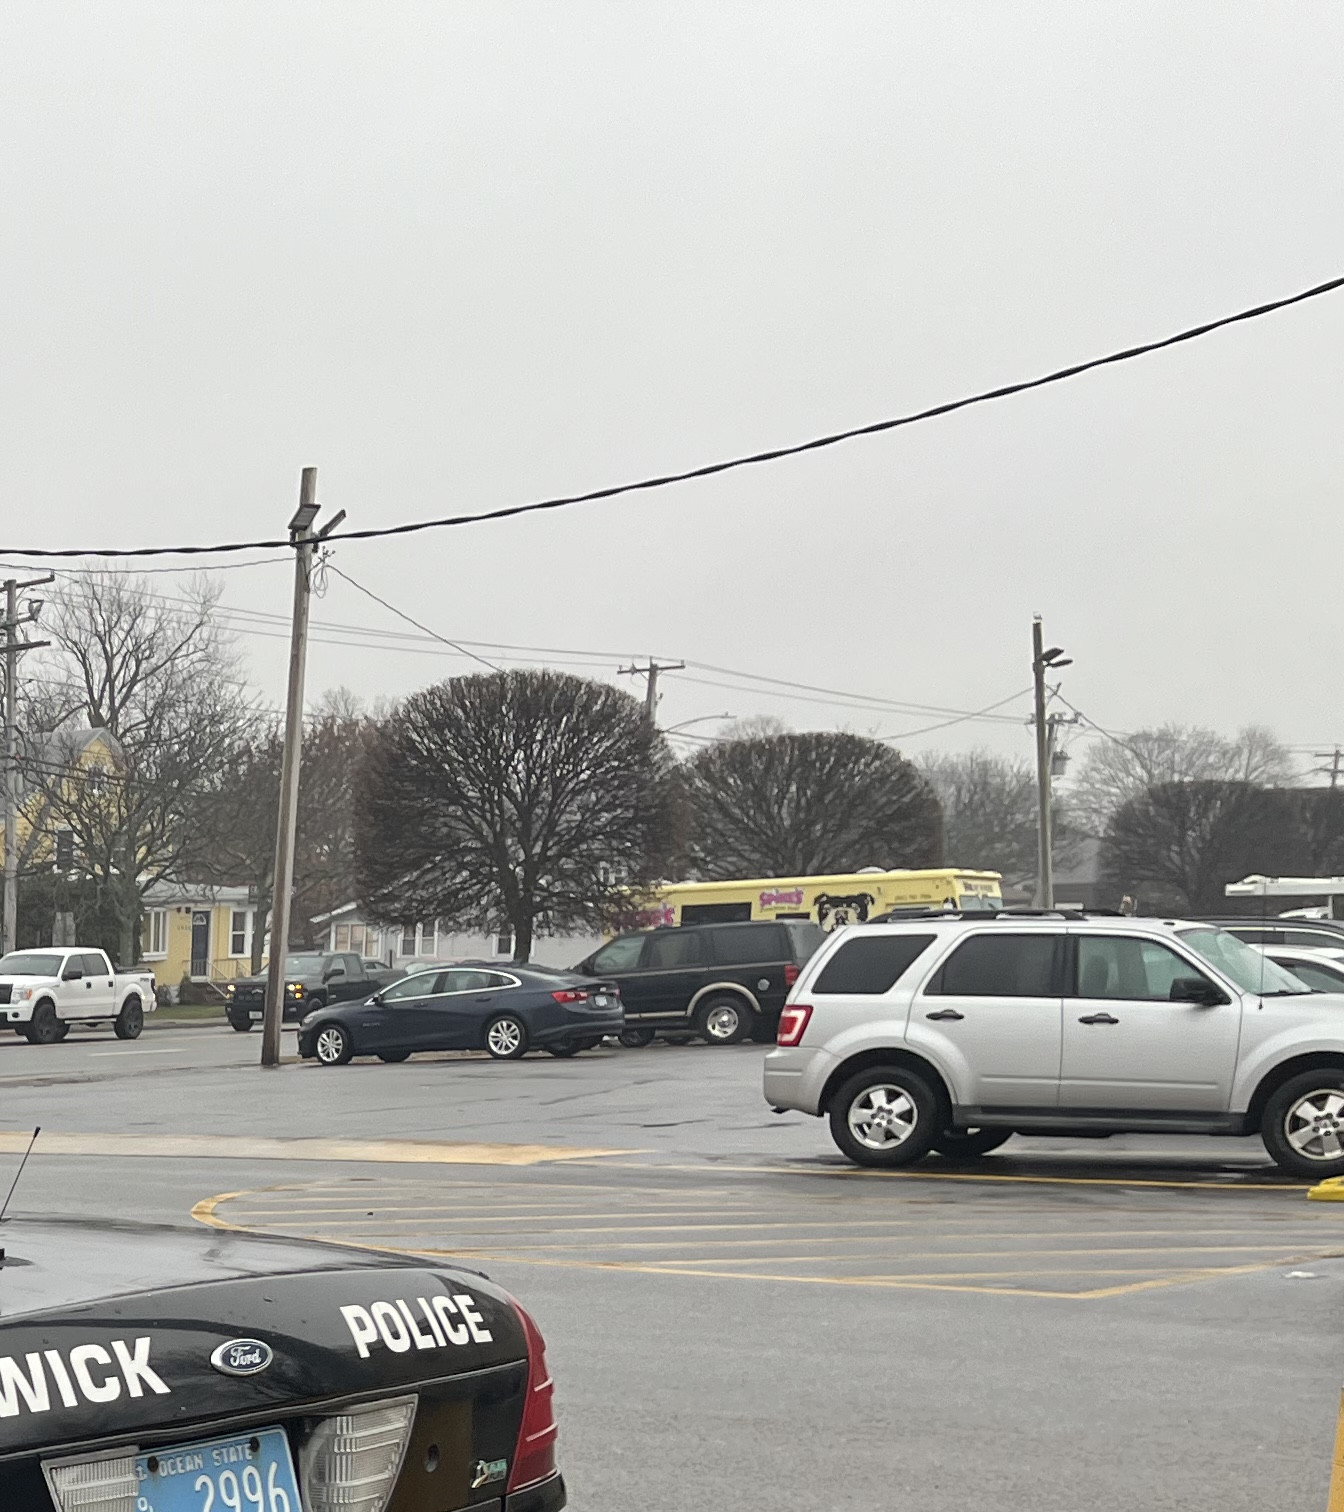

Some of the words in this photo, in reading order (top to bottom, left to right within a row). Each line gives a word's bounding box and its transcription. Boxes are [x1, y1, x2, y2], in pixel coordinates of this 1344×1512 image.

[339, 1294, 494, 1359] POLICE
[230, 1345, 262, 1367] Ford
[159, 1454, 204, 1477] OCEAN
[211, 1442, 253, 1467] STATE
